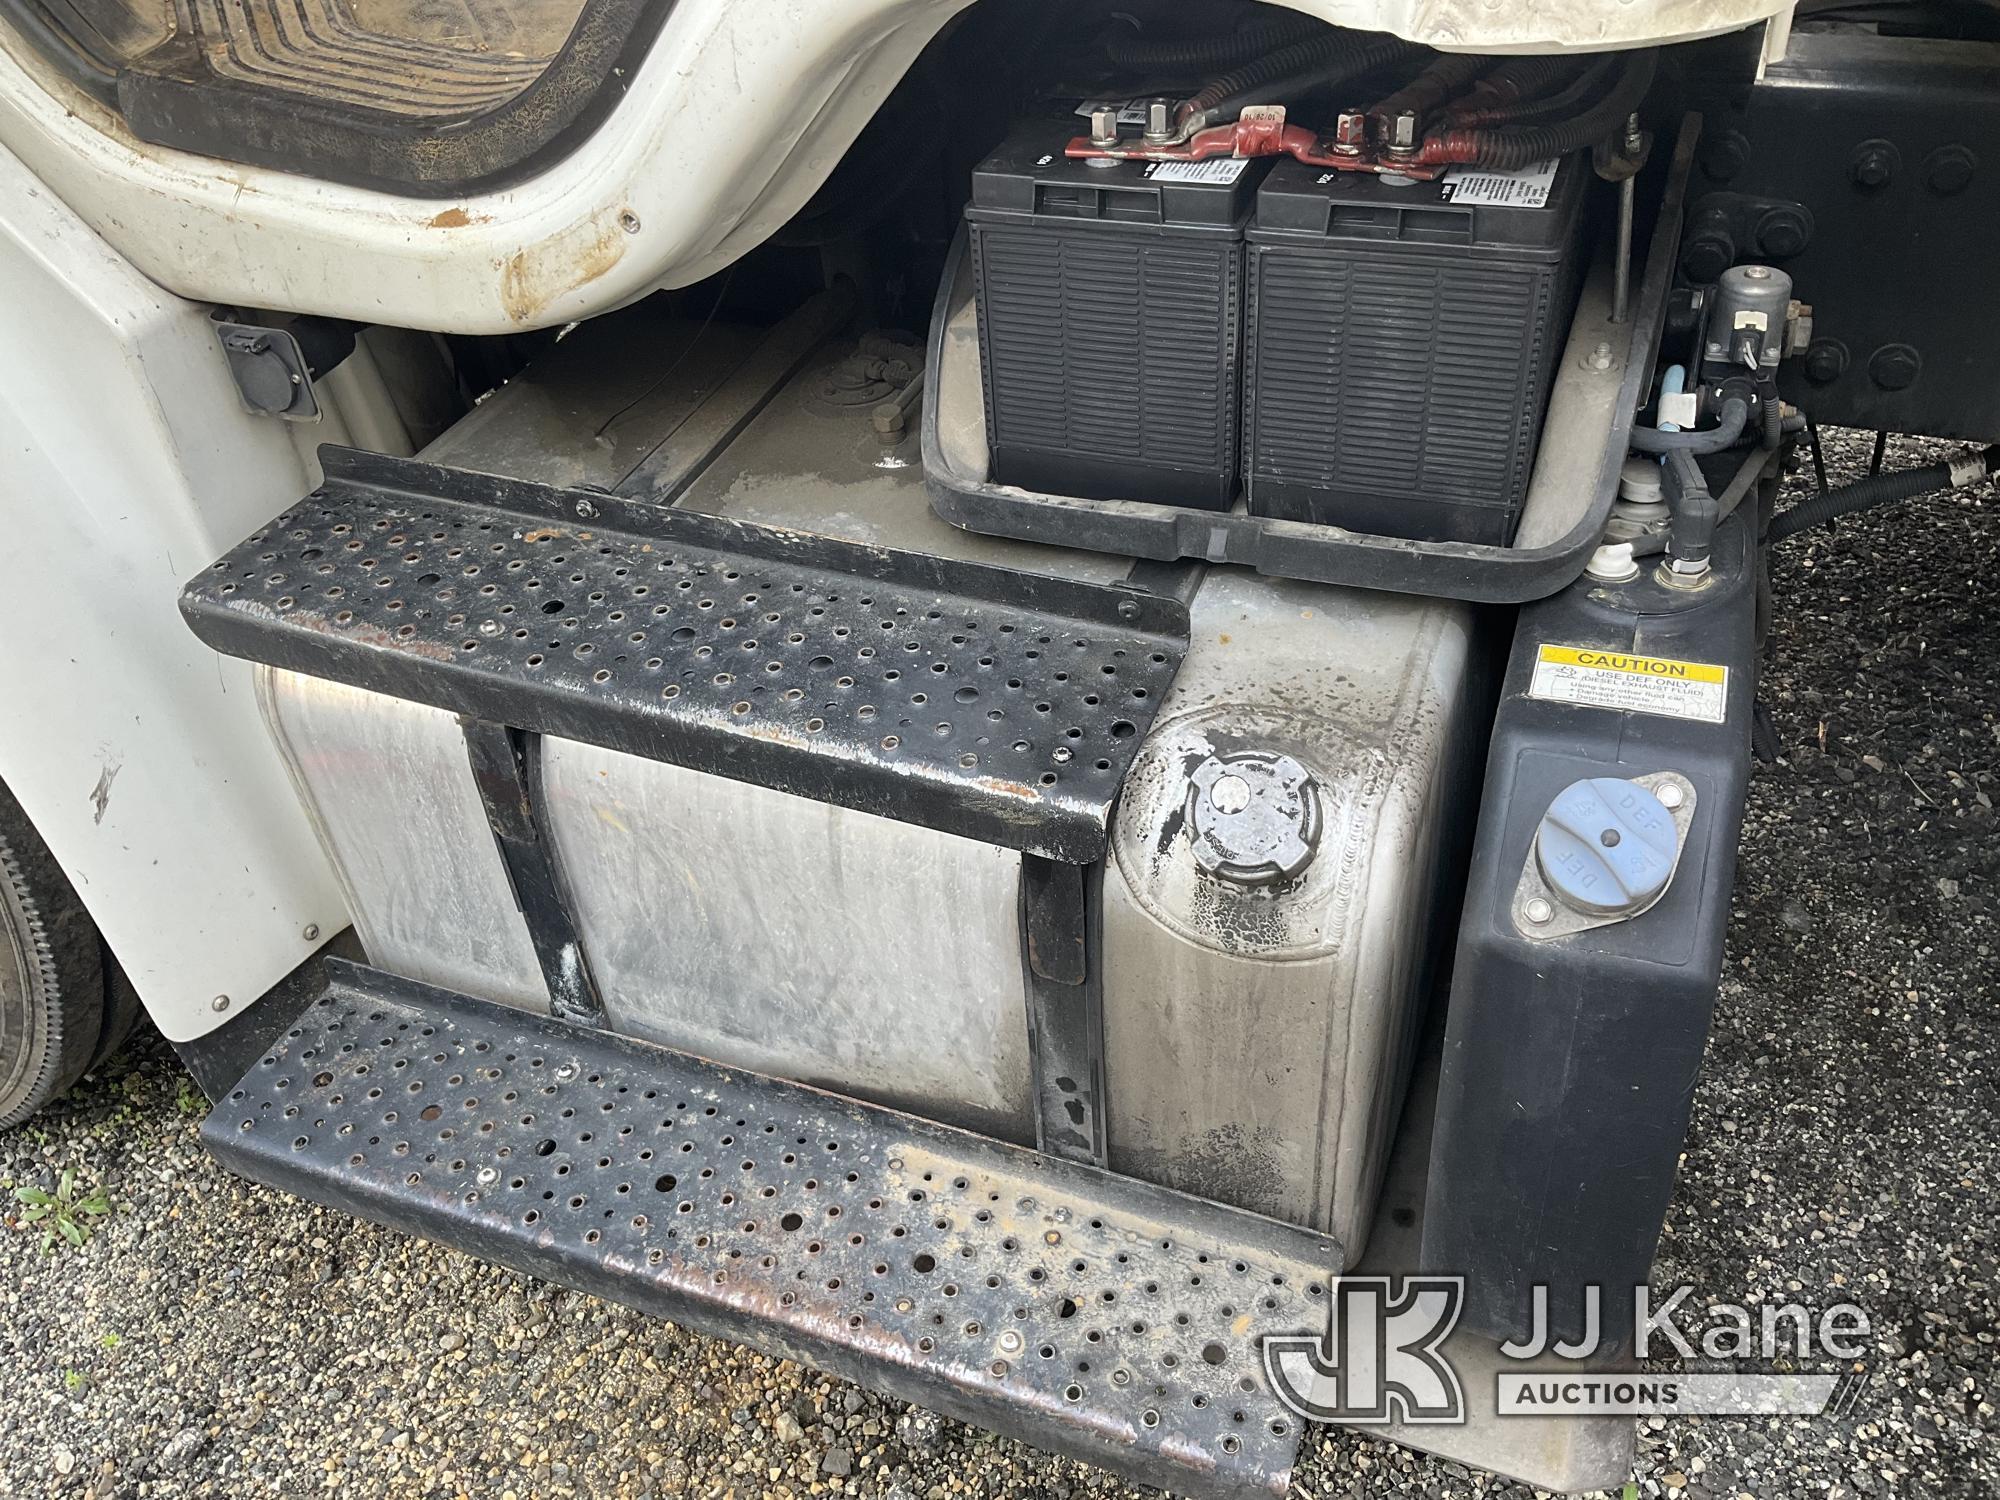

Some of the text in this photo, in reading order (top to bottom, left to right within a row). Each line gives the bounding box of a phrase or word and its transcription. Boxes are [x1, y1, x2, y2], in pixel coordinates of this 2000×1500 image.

[1577, 653, 1685, 676] CAUTION
[1596, 671, 1690, 688] USE DEF ONLY
[1570, 682, 1597, 691] Using
[1617, 687, 1643, 696] other
[1644, 690, 1665, 699] fluid
[1621, 681, 1668, 692] EXHAUST
[1671, 687, 1704, 697] FLUID)
[1616, 693, 1650, 703] vehicle
[1637, 703, 1680, 713] economy
